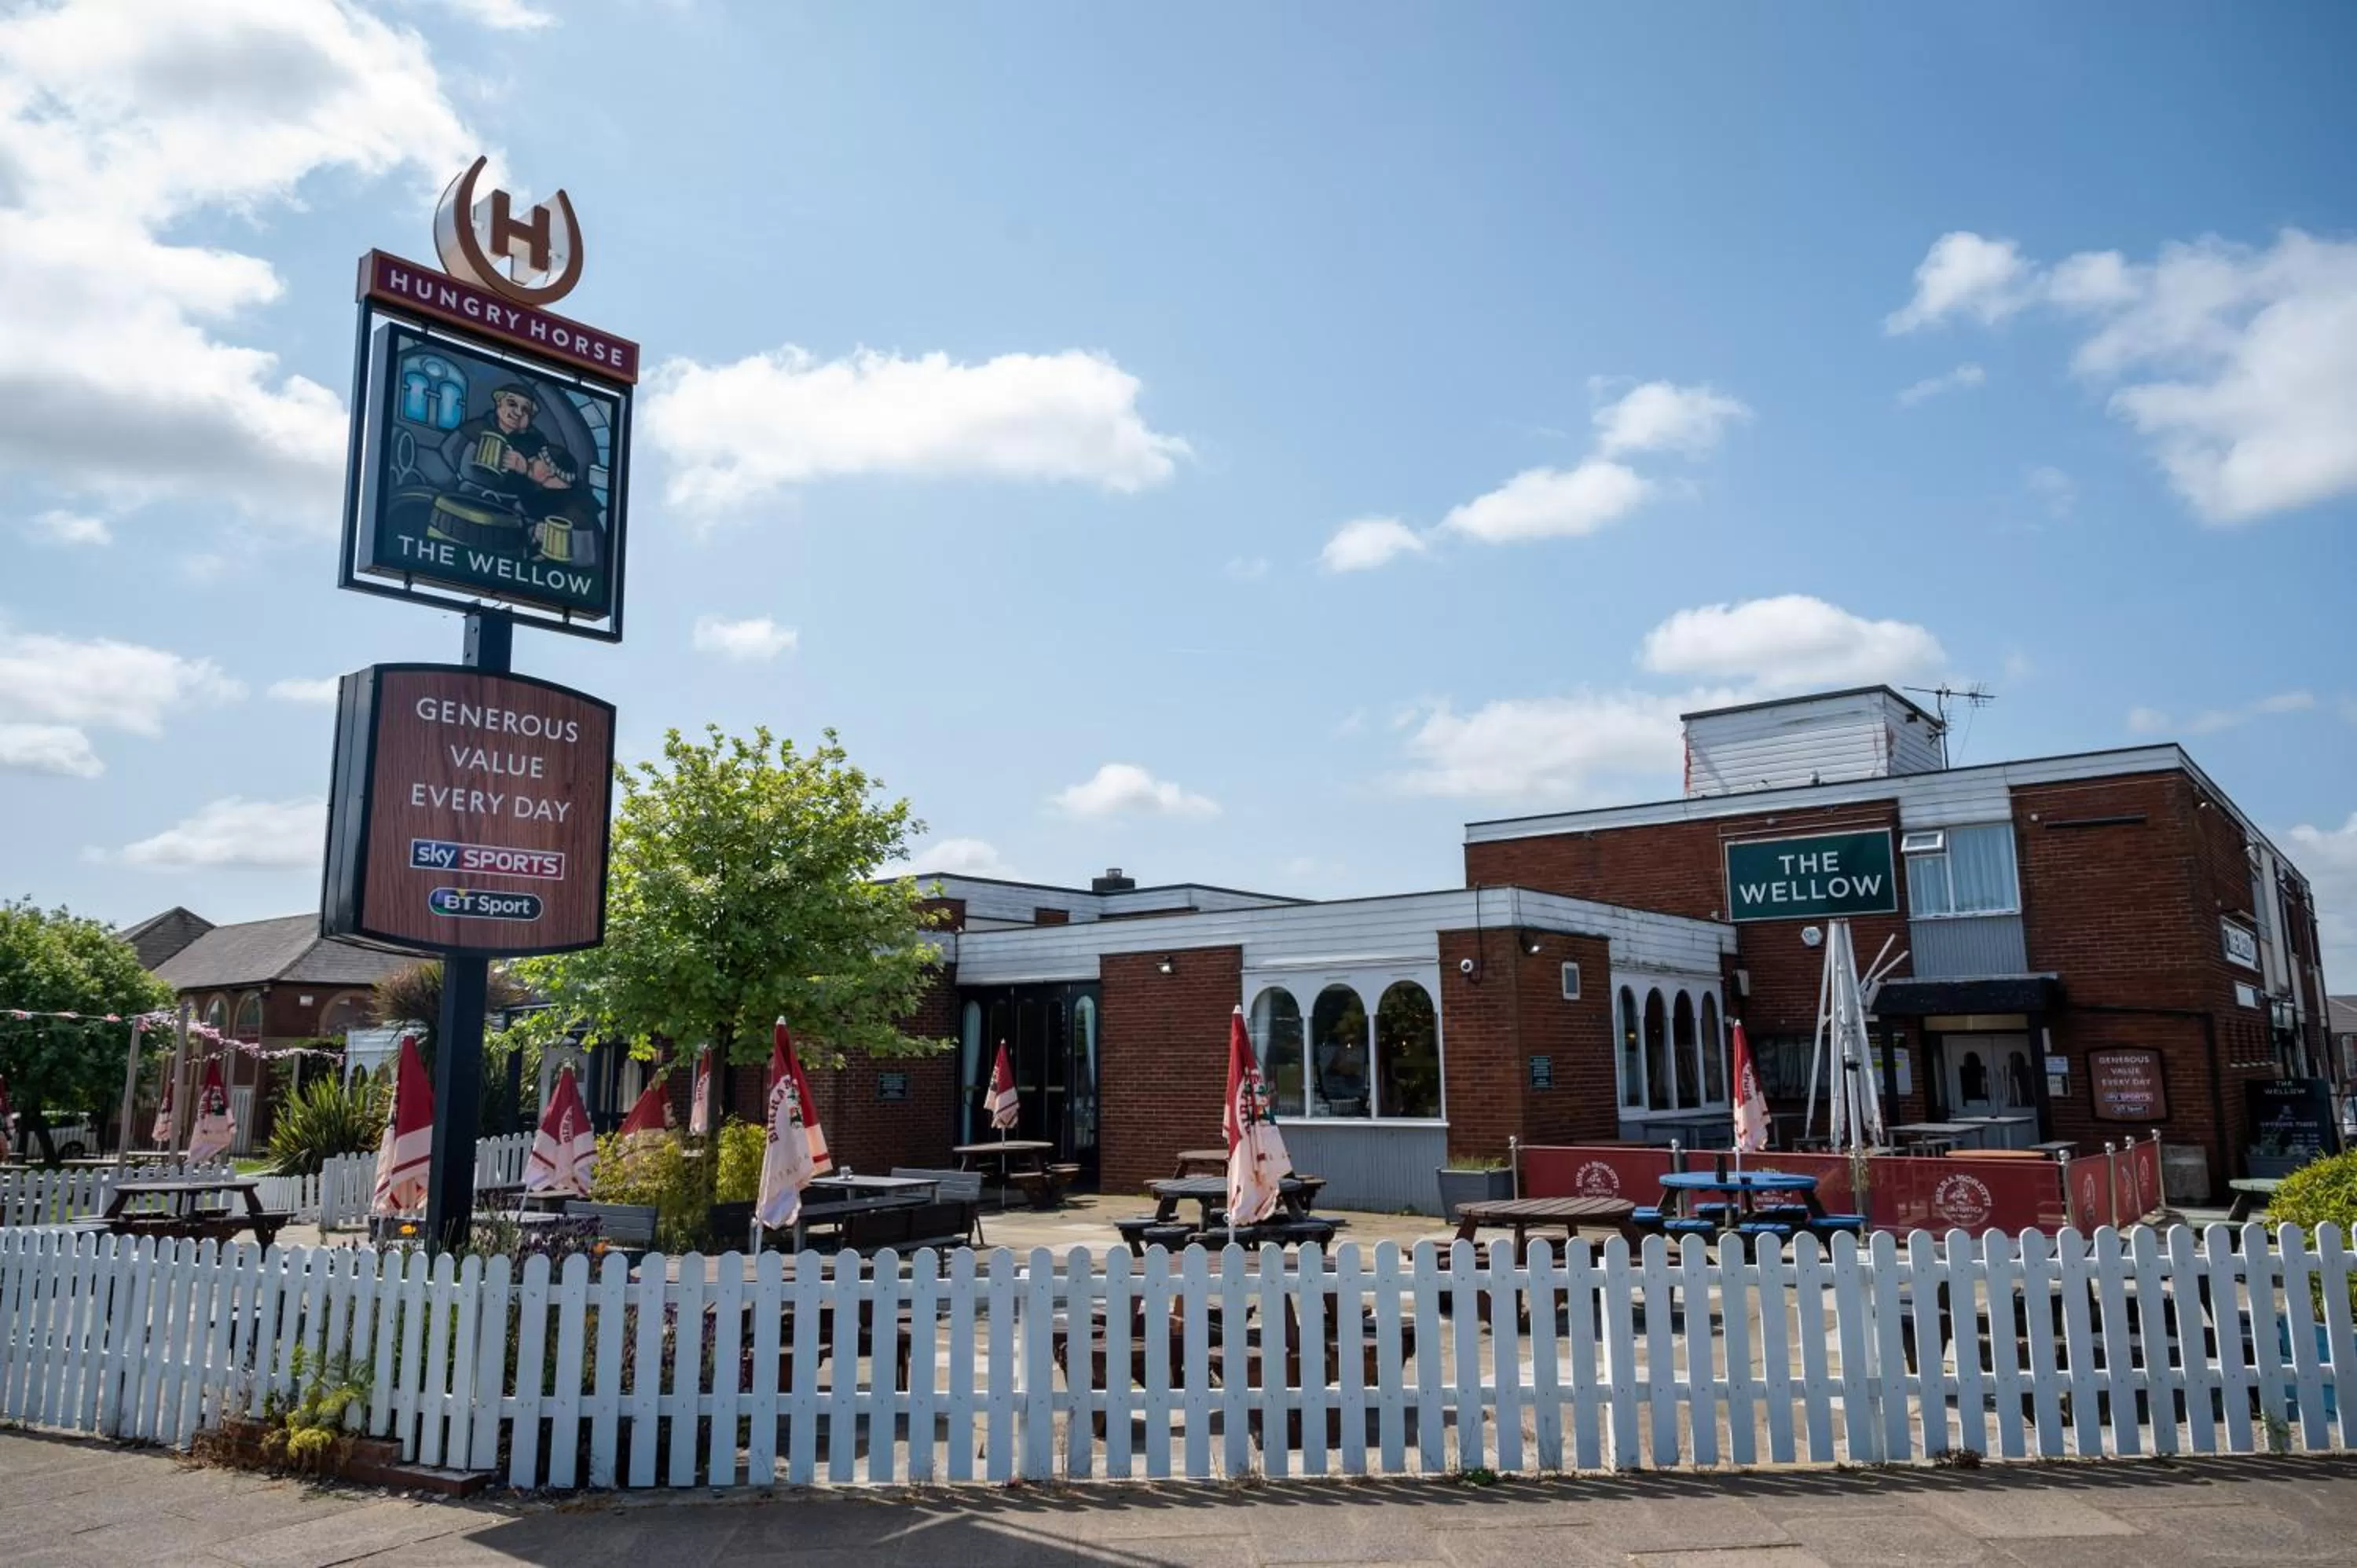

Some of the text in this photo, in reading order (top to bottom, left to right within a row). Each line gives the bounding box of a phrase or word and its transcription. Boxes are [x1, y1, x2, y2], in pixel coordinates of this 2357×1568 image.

[390, 269, 624, 367] HUNGRY HORSE
[398, 535, 592, 595] THE WELLOW
[416, 698, 579, 742] GENEROUS
[451, 745, 544, 779] VALUE
[412, 783, 572, 823] EVERY DAY
[417, 843, 558, 875] sky SPORTS
[1778, 851, 1839, 875] THE
[444, 894, 530, 916] BT Sport
[1739, 874, 1882, 904] WELLOW
